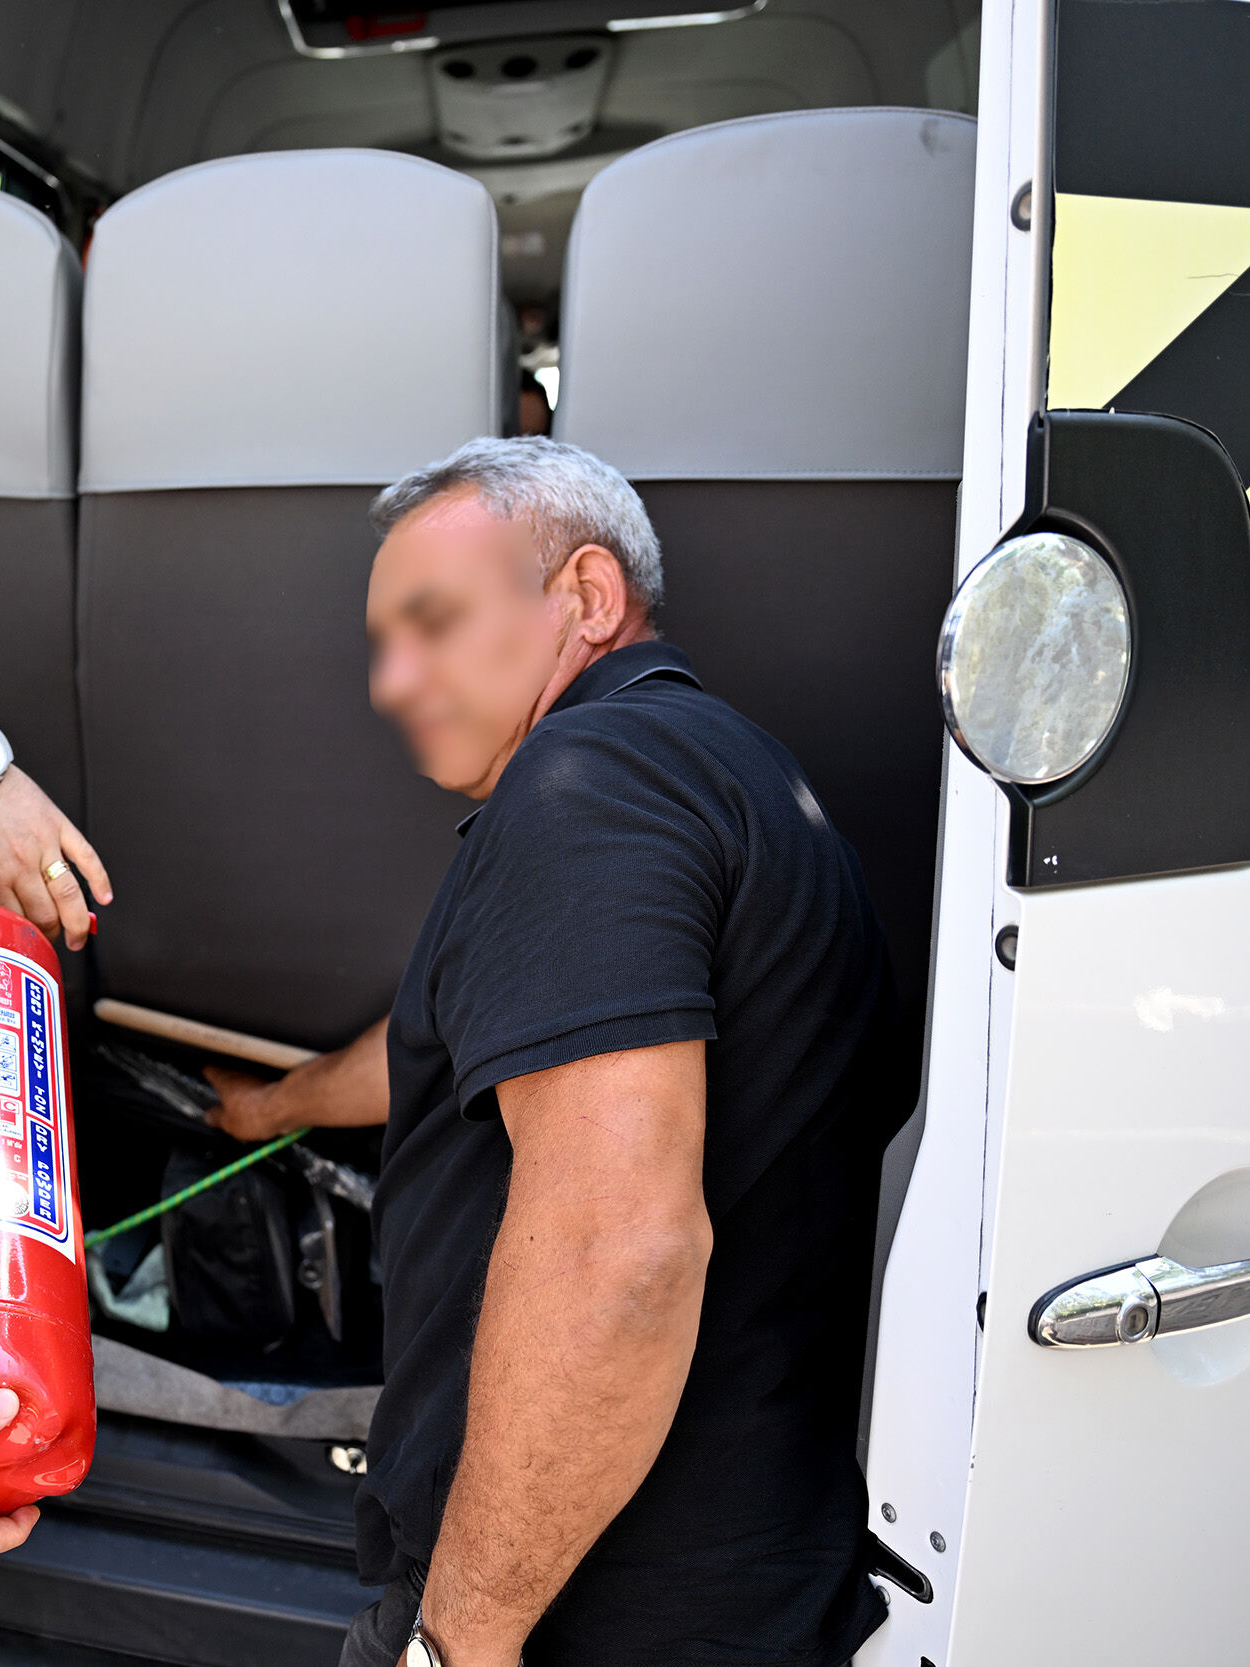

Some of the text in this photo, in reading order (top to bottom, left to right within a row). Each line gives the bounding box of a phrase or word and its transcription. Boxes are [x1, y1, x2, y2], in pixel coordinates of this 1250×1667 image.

[29, 982, 43, 1016] KURU
[3, 1101, 17, 1112] C
[34, 1085, 47, 1114] TOZ
[13, 1154, 22, 1163] C
[36, 1124, 52, 1219] DRY POWDER
